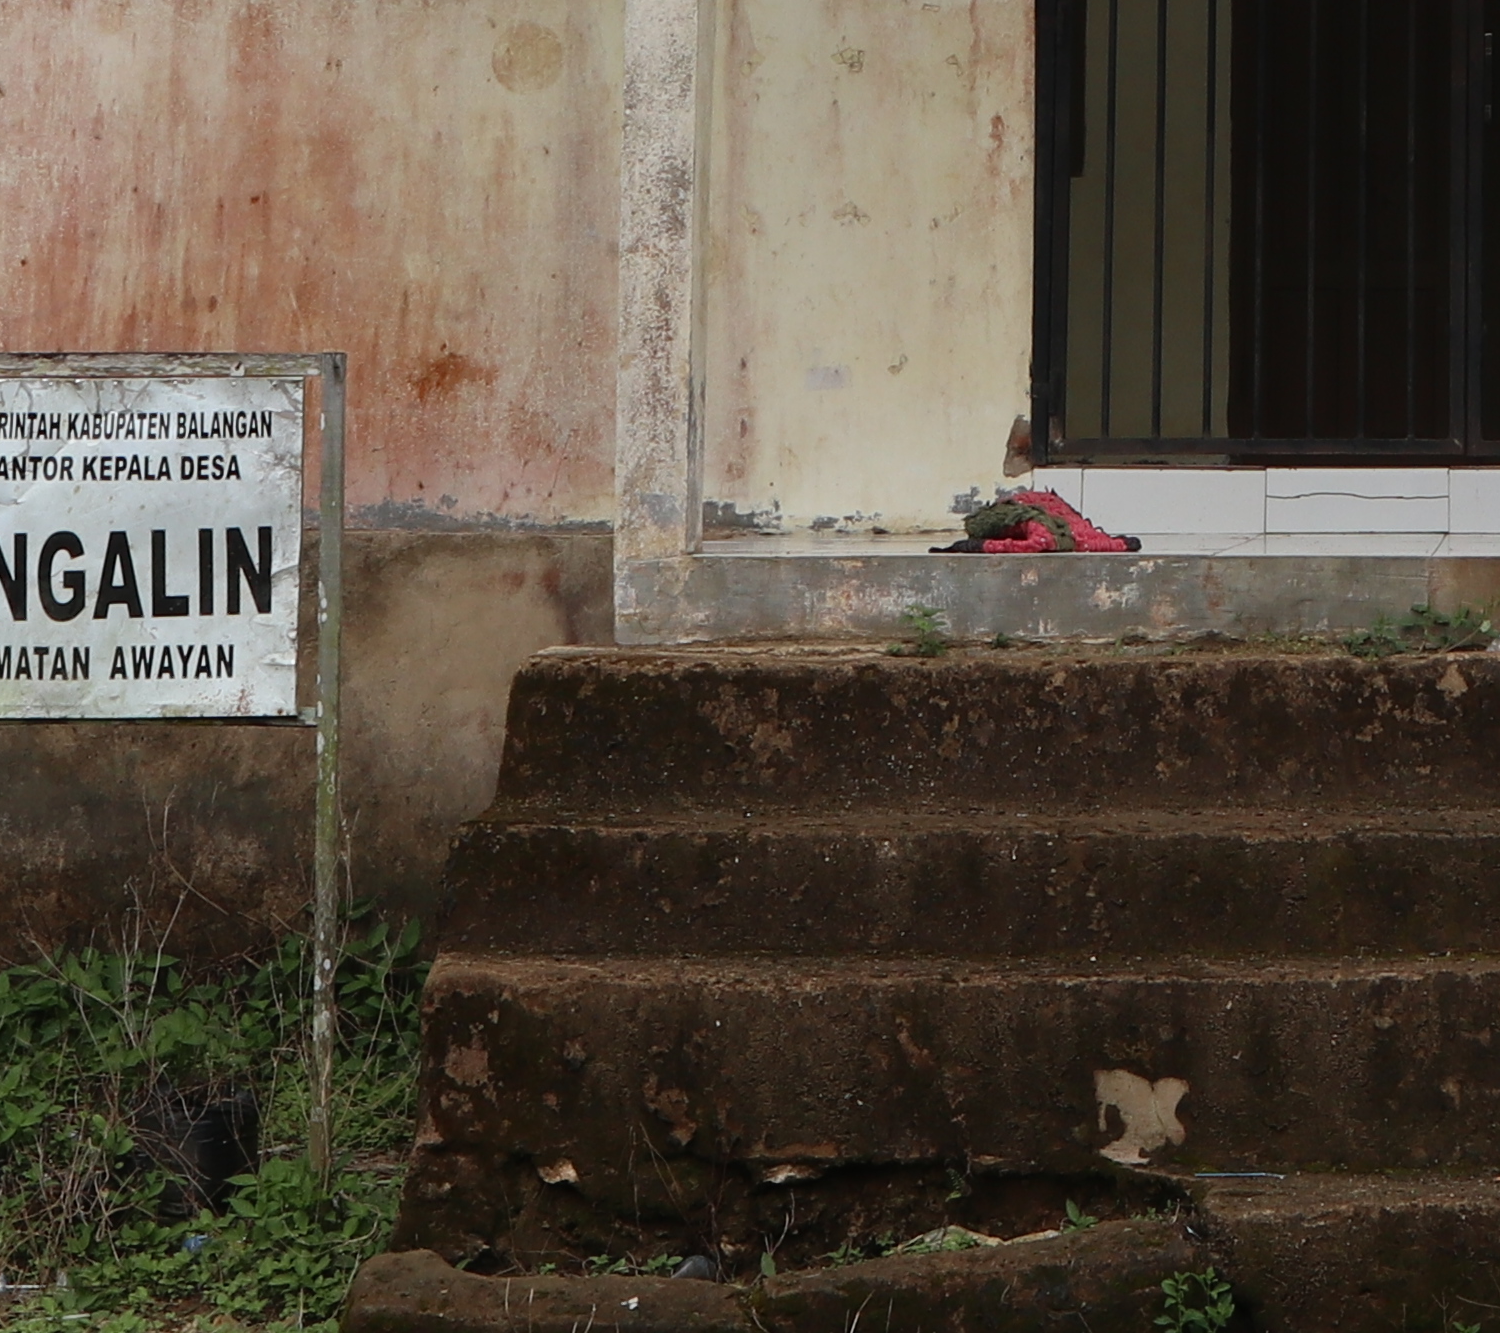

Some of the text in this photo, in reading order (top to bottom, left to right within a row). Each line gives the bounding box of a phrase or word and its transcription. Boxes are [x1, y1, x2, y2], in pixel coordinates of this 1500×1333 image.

[68, 412, 169, 441] KABUPATEN
[176, 411, 273, 440] BALANGAN
[81, 454, 171, 481] KEPALA
[180, 454, 242, 481] DESA
[109, 644, 234, 680] AWAYAN
